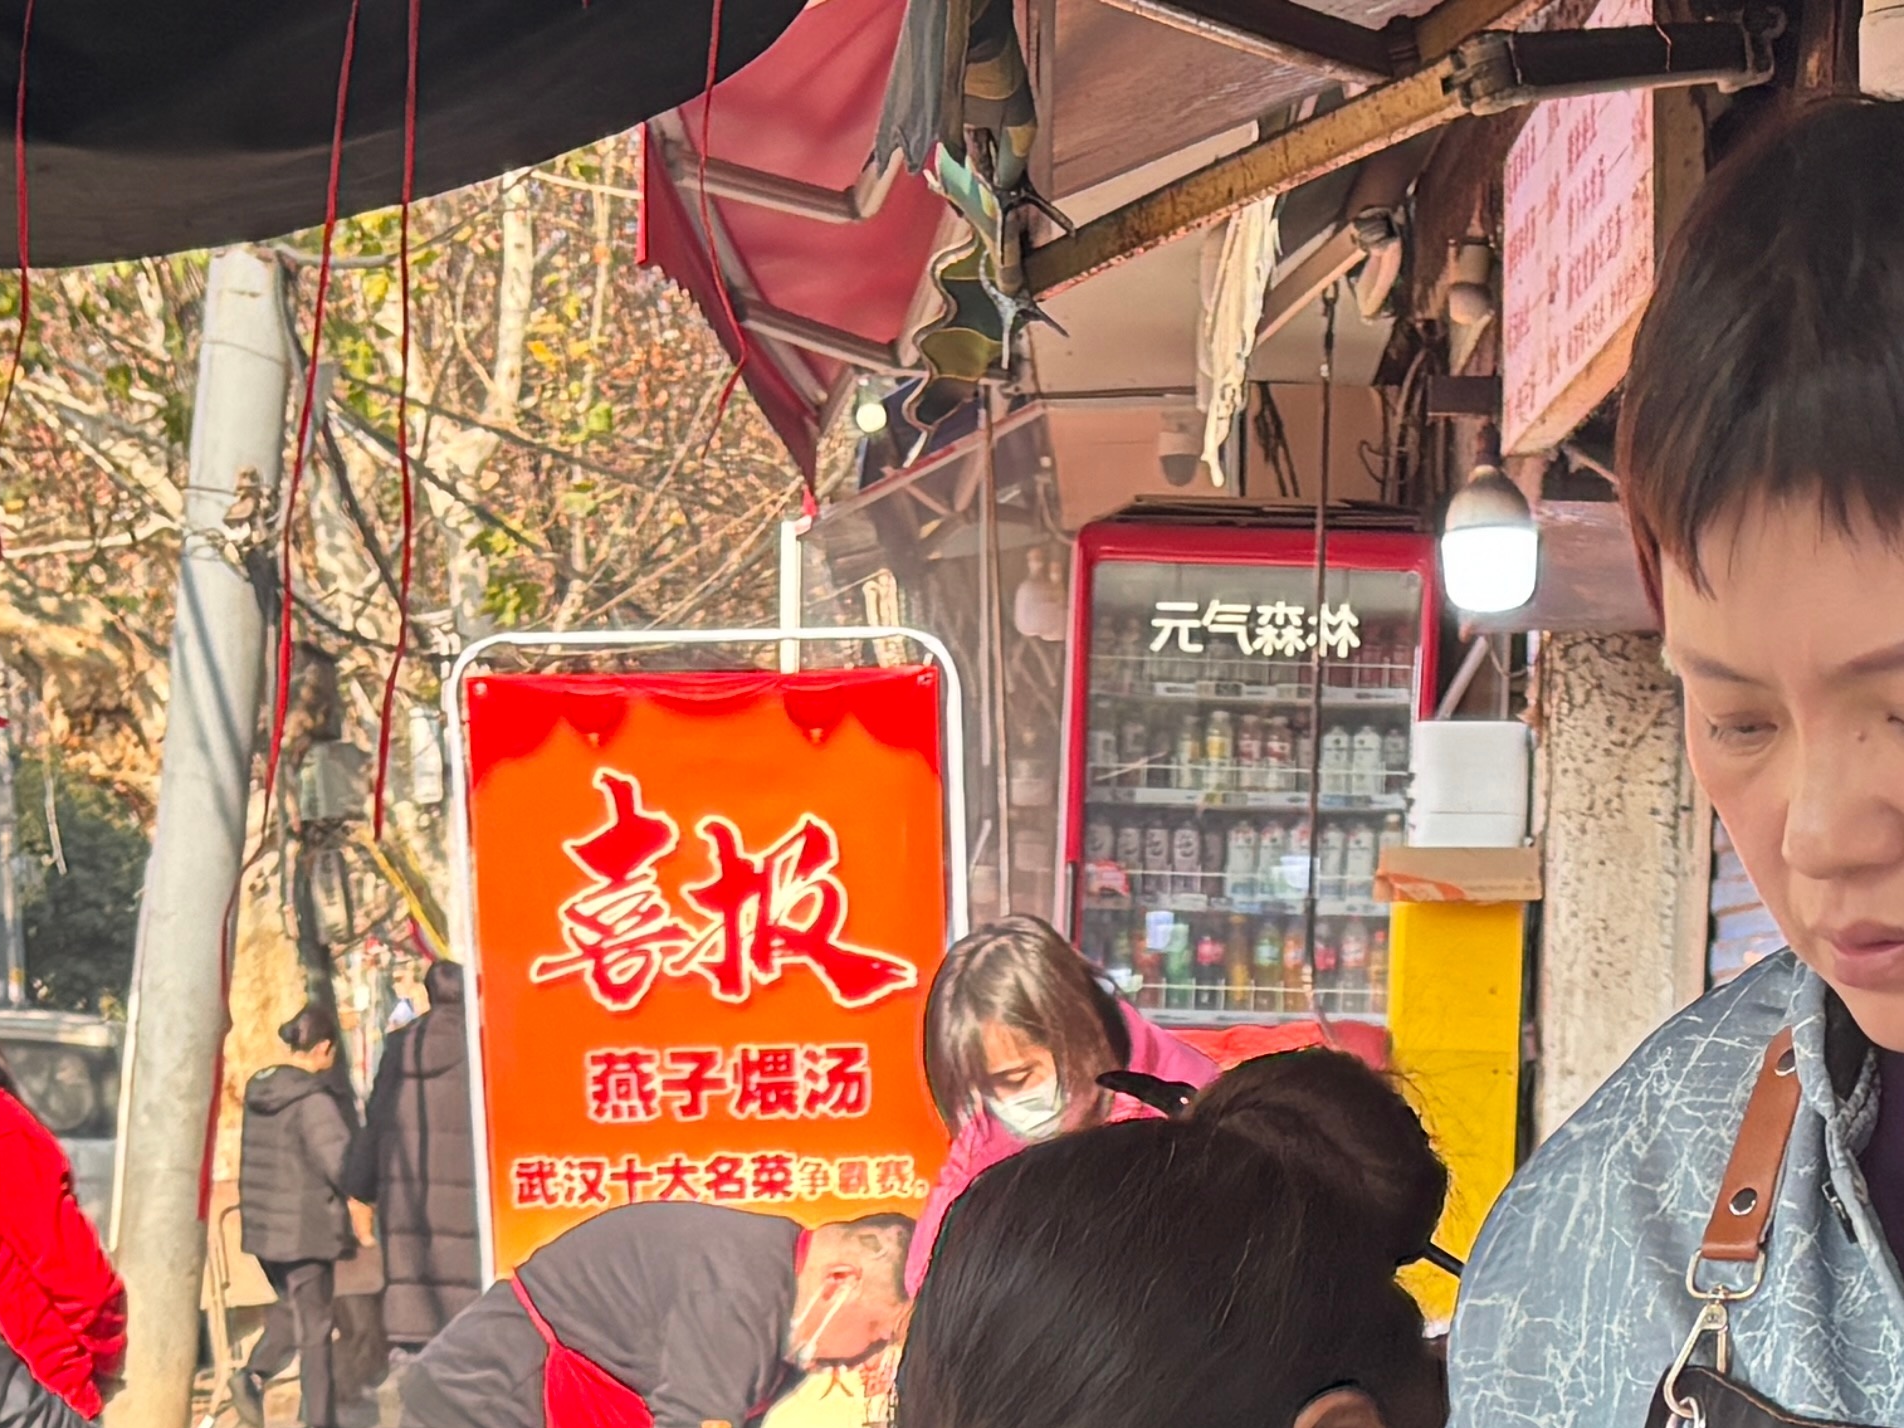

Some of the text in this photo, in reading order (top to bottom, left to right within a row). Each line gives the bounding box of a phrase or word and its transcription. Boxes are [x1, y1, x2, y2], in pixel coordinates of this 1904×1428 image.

[1149, 599, 1361, 658] 元气森林
[530, 769, 918, 1011] 喜报
[586, 1044, 873, 1124] 燕子煨汤
